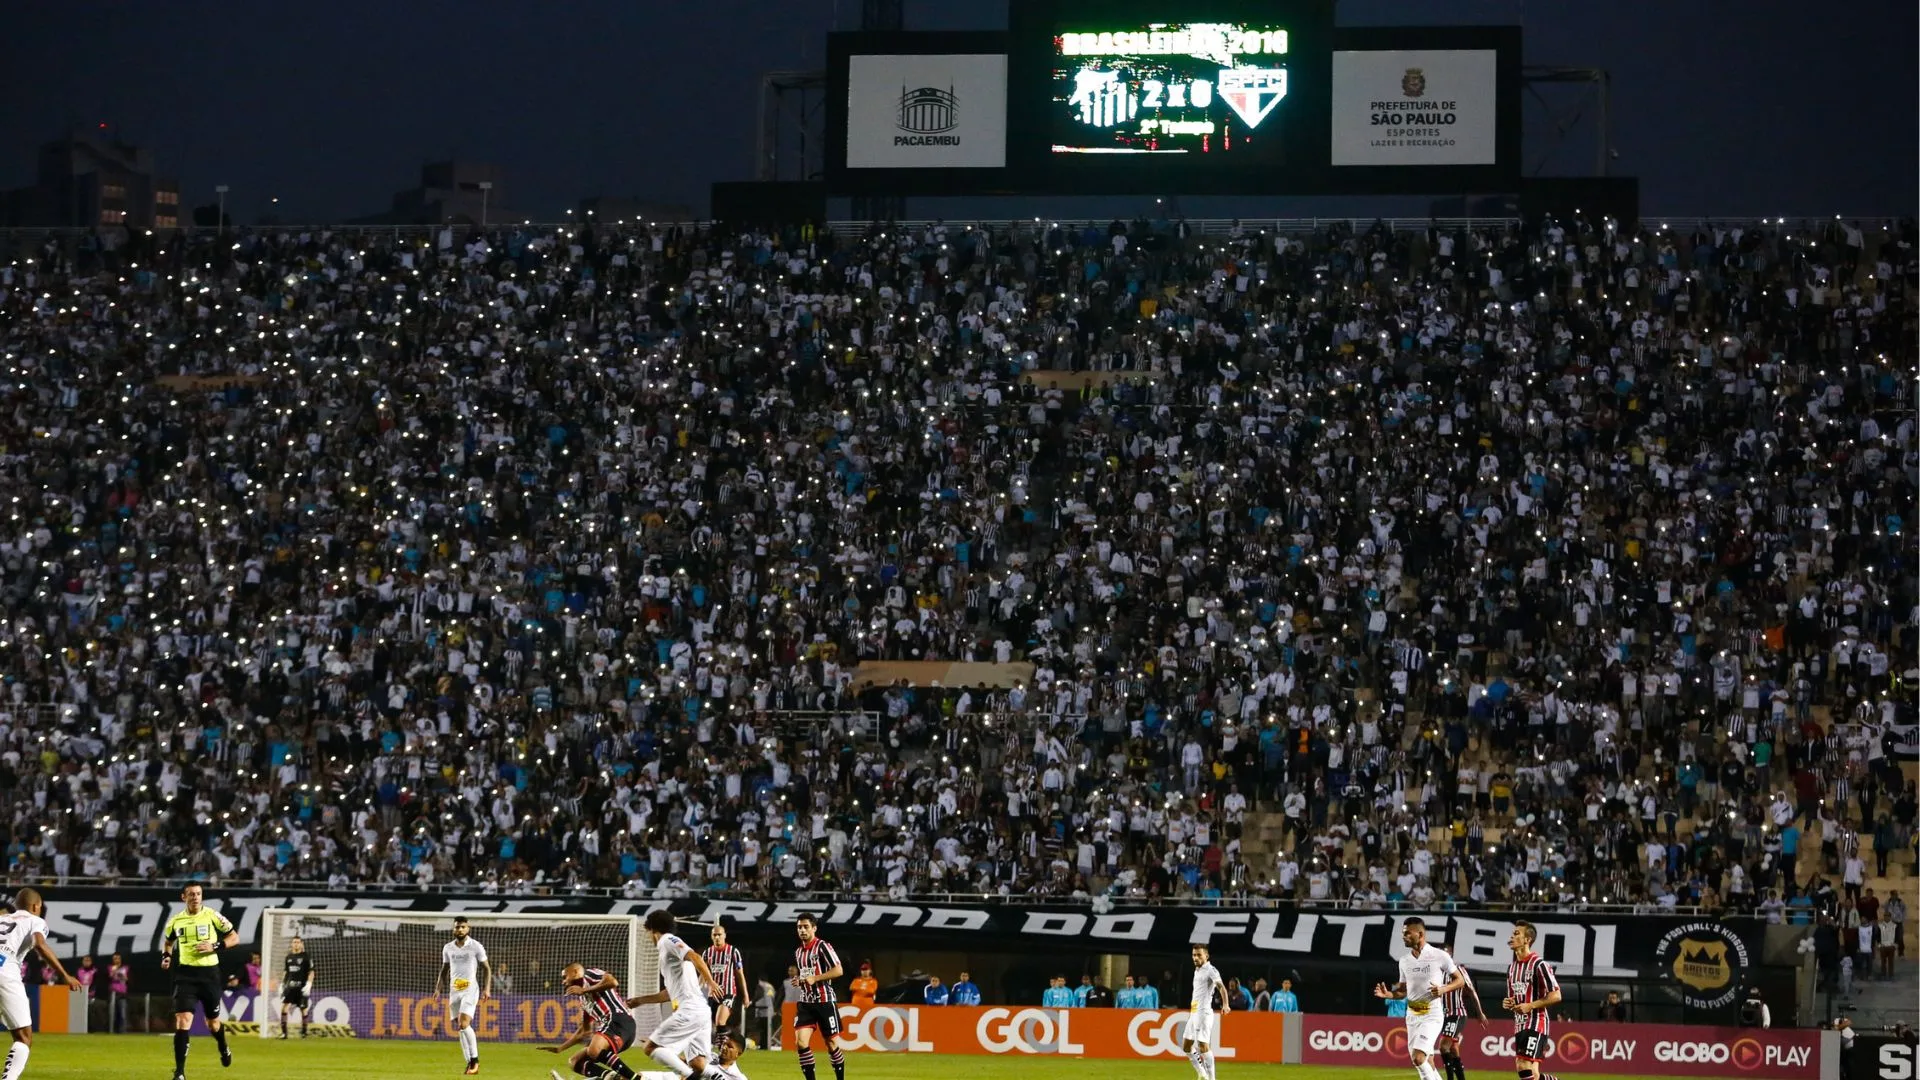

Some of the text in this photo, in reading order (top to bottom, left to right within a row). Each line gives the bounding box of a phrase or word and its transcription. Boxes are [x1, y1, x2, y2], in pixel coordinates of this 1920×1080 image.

[1060, 31, 1227, 55] BRASILEIR
[1142, 79, 1162, 107] 2
[1190, 79, 1212, 108] 0
[1223, 74, 1282, 89] SPFC
[1370, 101, 1456, 110] PREFEITURA DE
[1371, 111, 1456, 125] SÃO PAULO
[894, 136, 960, 146] PACAEMBU
[1371, 139, 1397, 147] LAZER
[1407, 138, 1456, 147] RECREAÇÃO
[1387, 128, 1440, 137] ESPORTES
[700, 900, 990, 930] REINO
[1020, 911, 1156, 941] DO
[1189, 912, 1638, 977] FUTEBOL
[1656, 922, 1749, 967] THE FOOTBALL'S KINGDOM
[370, 997, 500, 1037] LIGE
[828, 1016, 836, 1028] 8
[837, 1006, 934, 1052] GOL
[1445, 1022, 1456, 1032] 28
[976, 1008, 1084, 1054] GOL
[1127, 1010, 1236, 1058] GOL
[1309, 1030, 1383, 1052] GLOBO
[1480, 1035, 1556, 1058] GLOO
[1590, 1039, 1637, 1060] PLAY
[1527, 1037, 1537, 1050] 15
[1654, 1041, 1811, 1067] GLOBO PLAY
[1879, 1043, 1918, 1080] S
